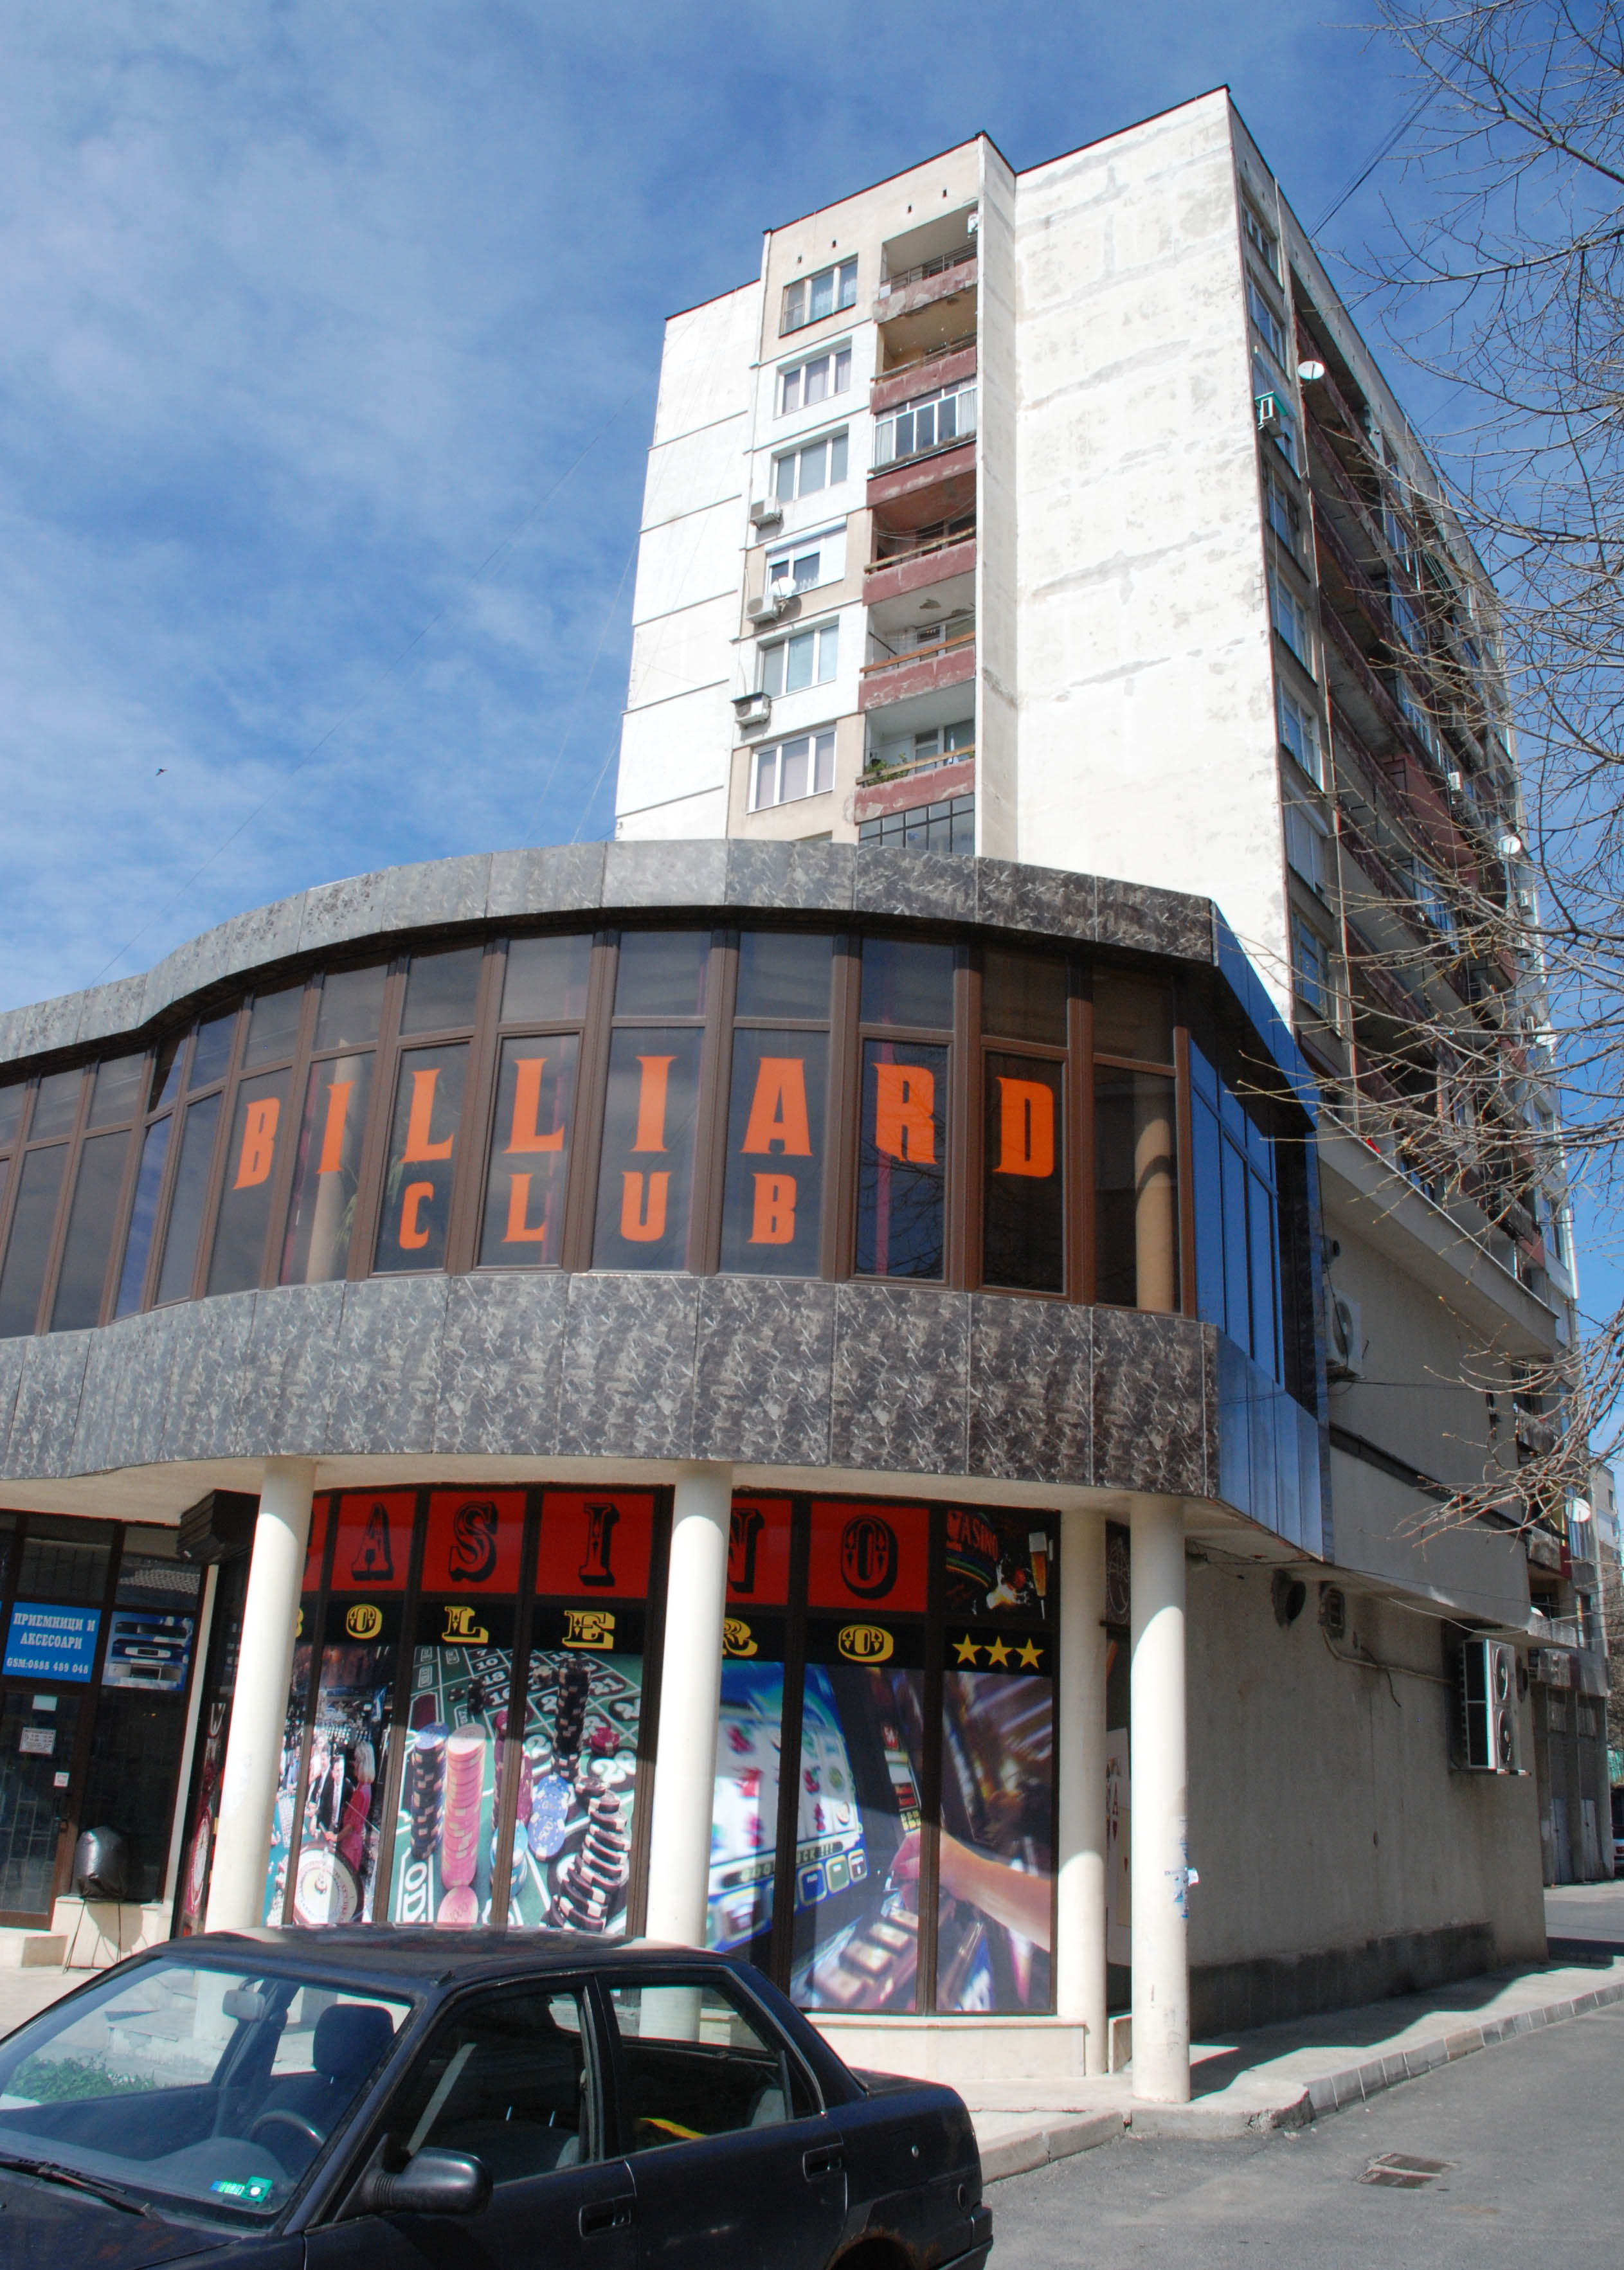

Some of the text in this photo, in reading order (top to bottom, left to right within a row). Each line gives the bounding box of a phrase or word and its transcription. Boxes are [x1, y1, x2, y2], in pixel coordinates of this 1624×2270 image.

[233, 1056, 1055, 1190] BILLIARD
[398, 1171, 797, 1250] CLUB
[303, 1501, 899, 1600] ASINO
[13, 1612, 96, 1632] ПРИЕМНИЦИ И
[20, 1632, 83, 1650] АКСЕСОАРИ
[295, 1603, 894, 1663] OLERO
[476, 1657, 498, 1671] 10
